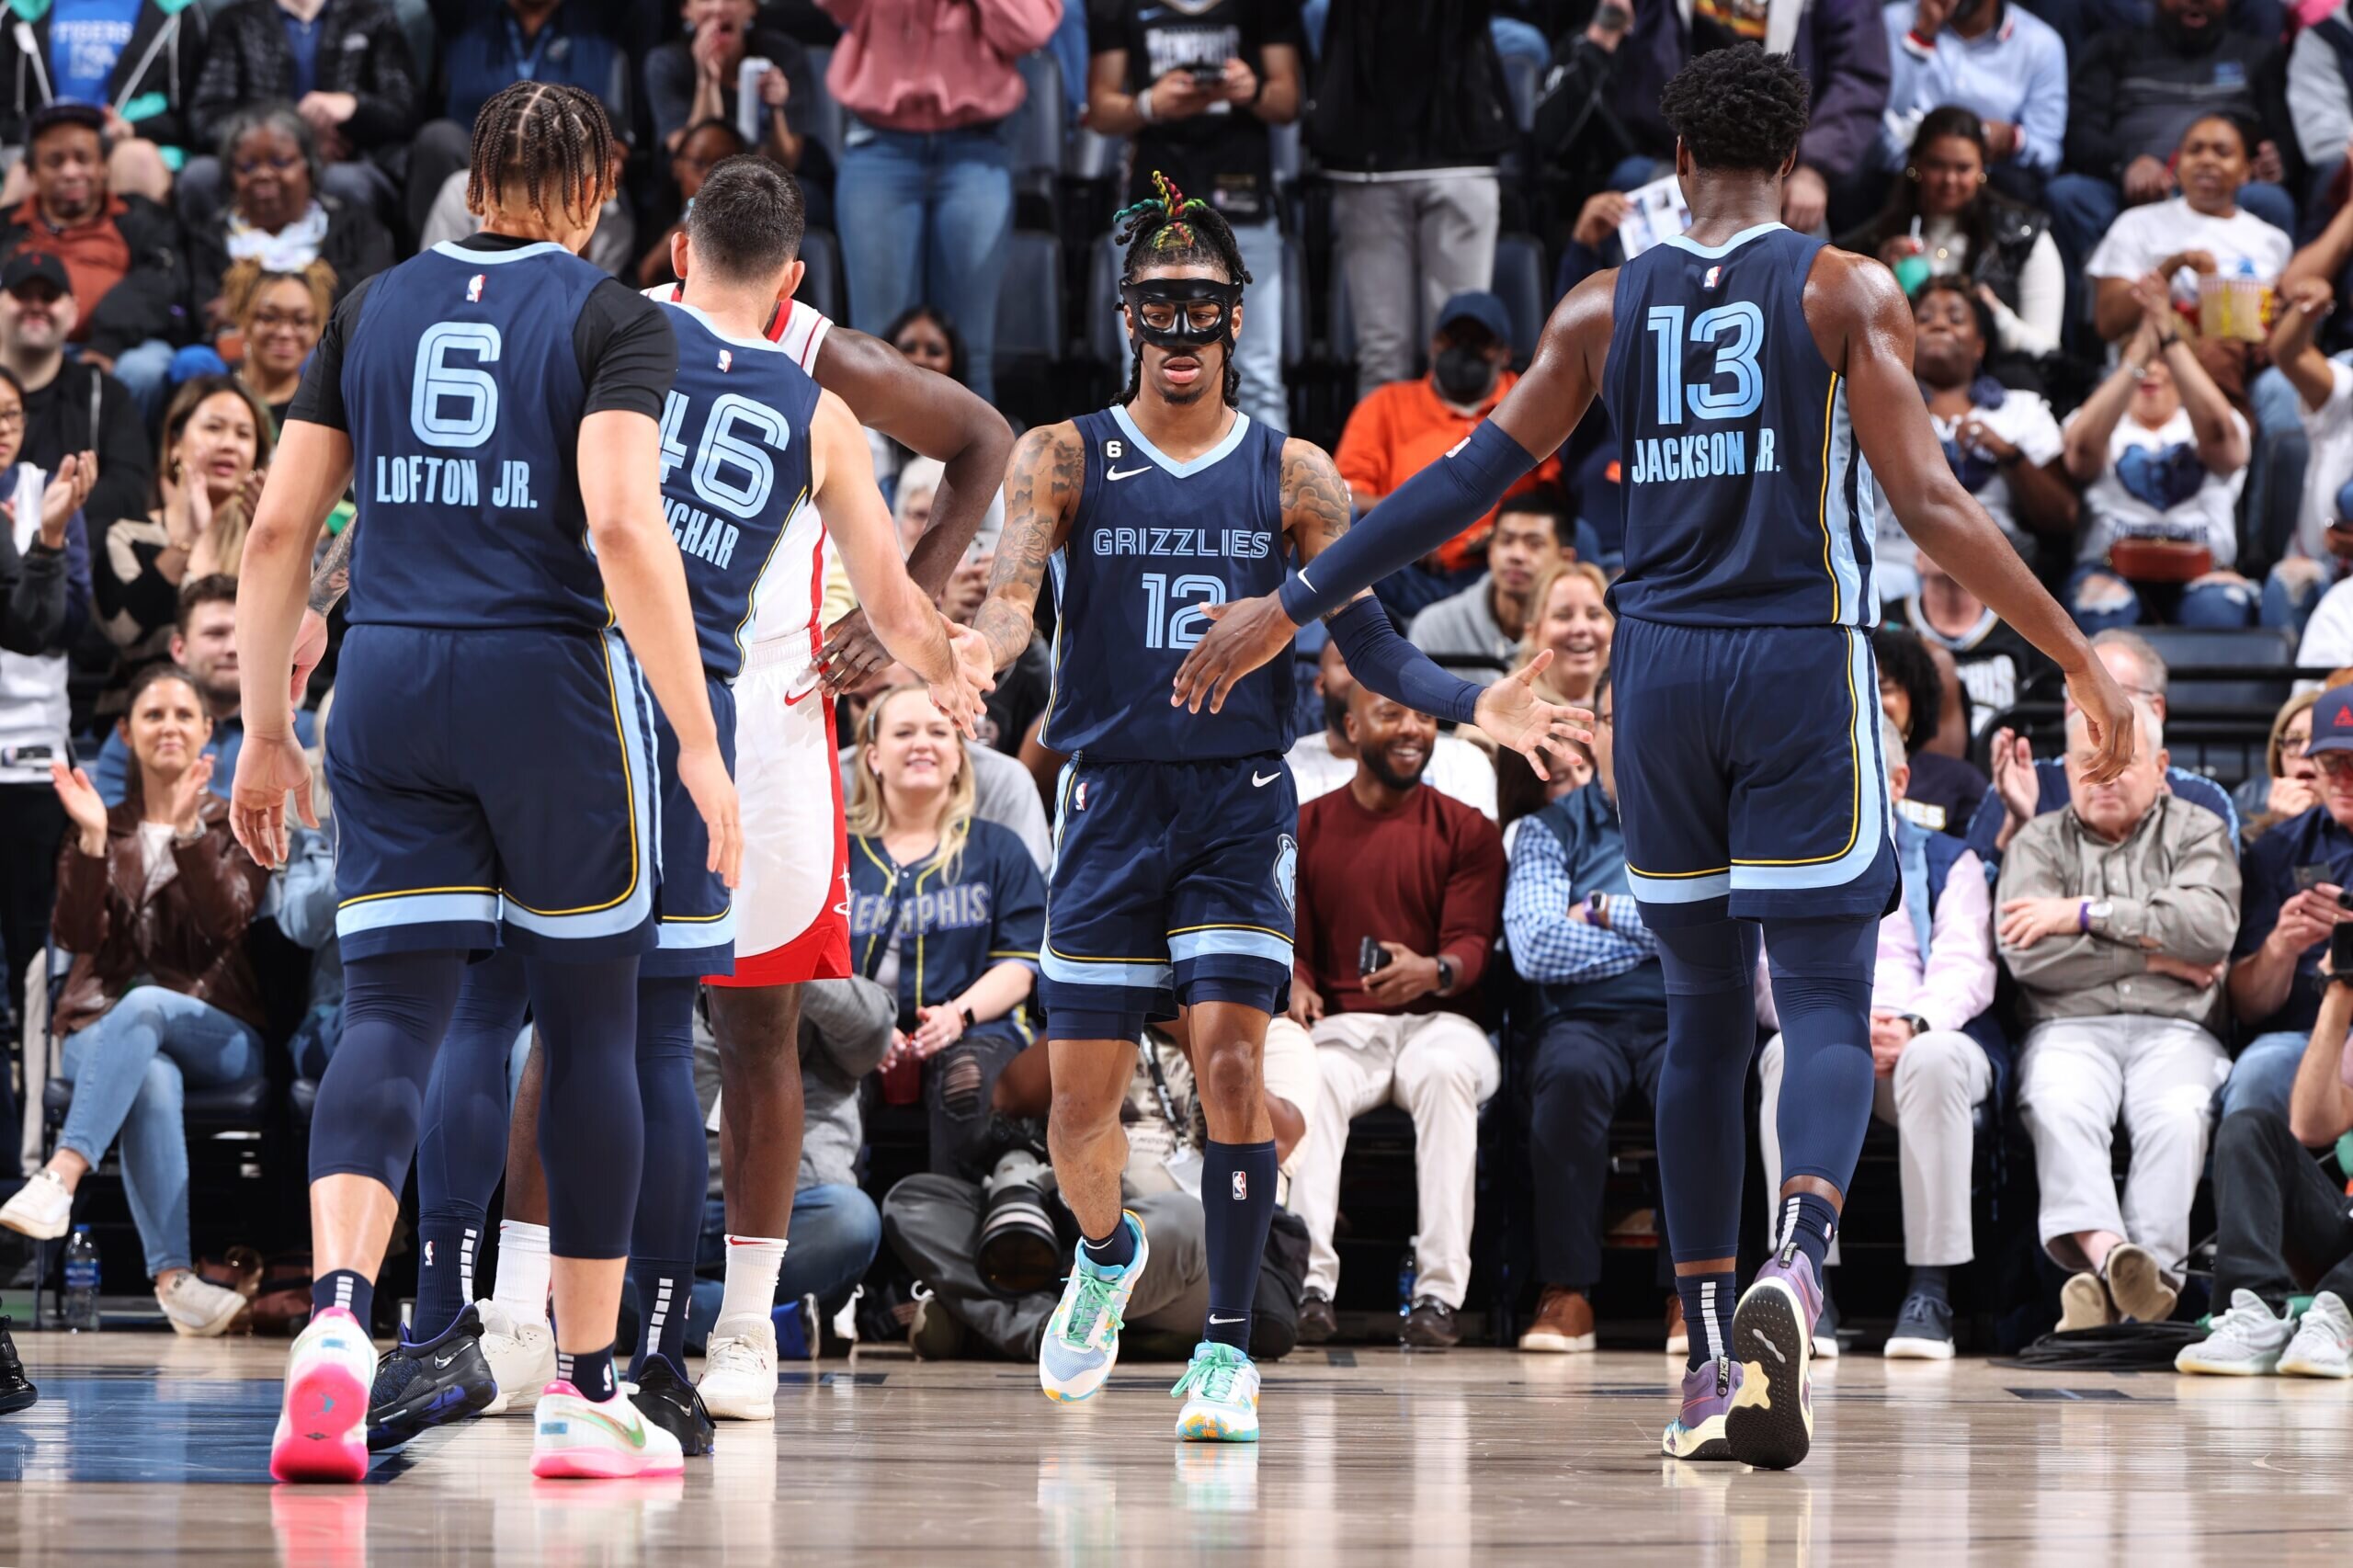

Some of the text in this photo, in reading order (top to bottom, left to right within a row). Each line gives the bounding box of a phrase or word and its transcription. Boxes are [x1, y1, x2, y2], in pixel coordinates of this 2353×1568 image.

[411, 322, 501, 448] 6
[1648, 301, 1765, 425] 13
[1107, 440, 1121, 458] 6
[1631, 431, 1745, 484] JACKSON
[377, 455, 538, 508] LOFTON JR.
[1093, 528, 1271, 558] GRIZZLIES
[1142, 573, 1226, 650] 12
